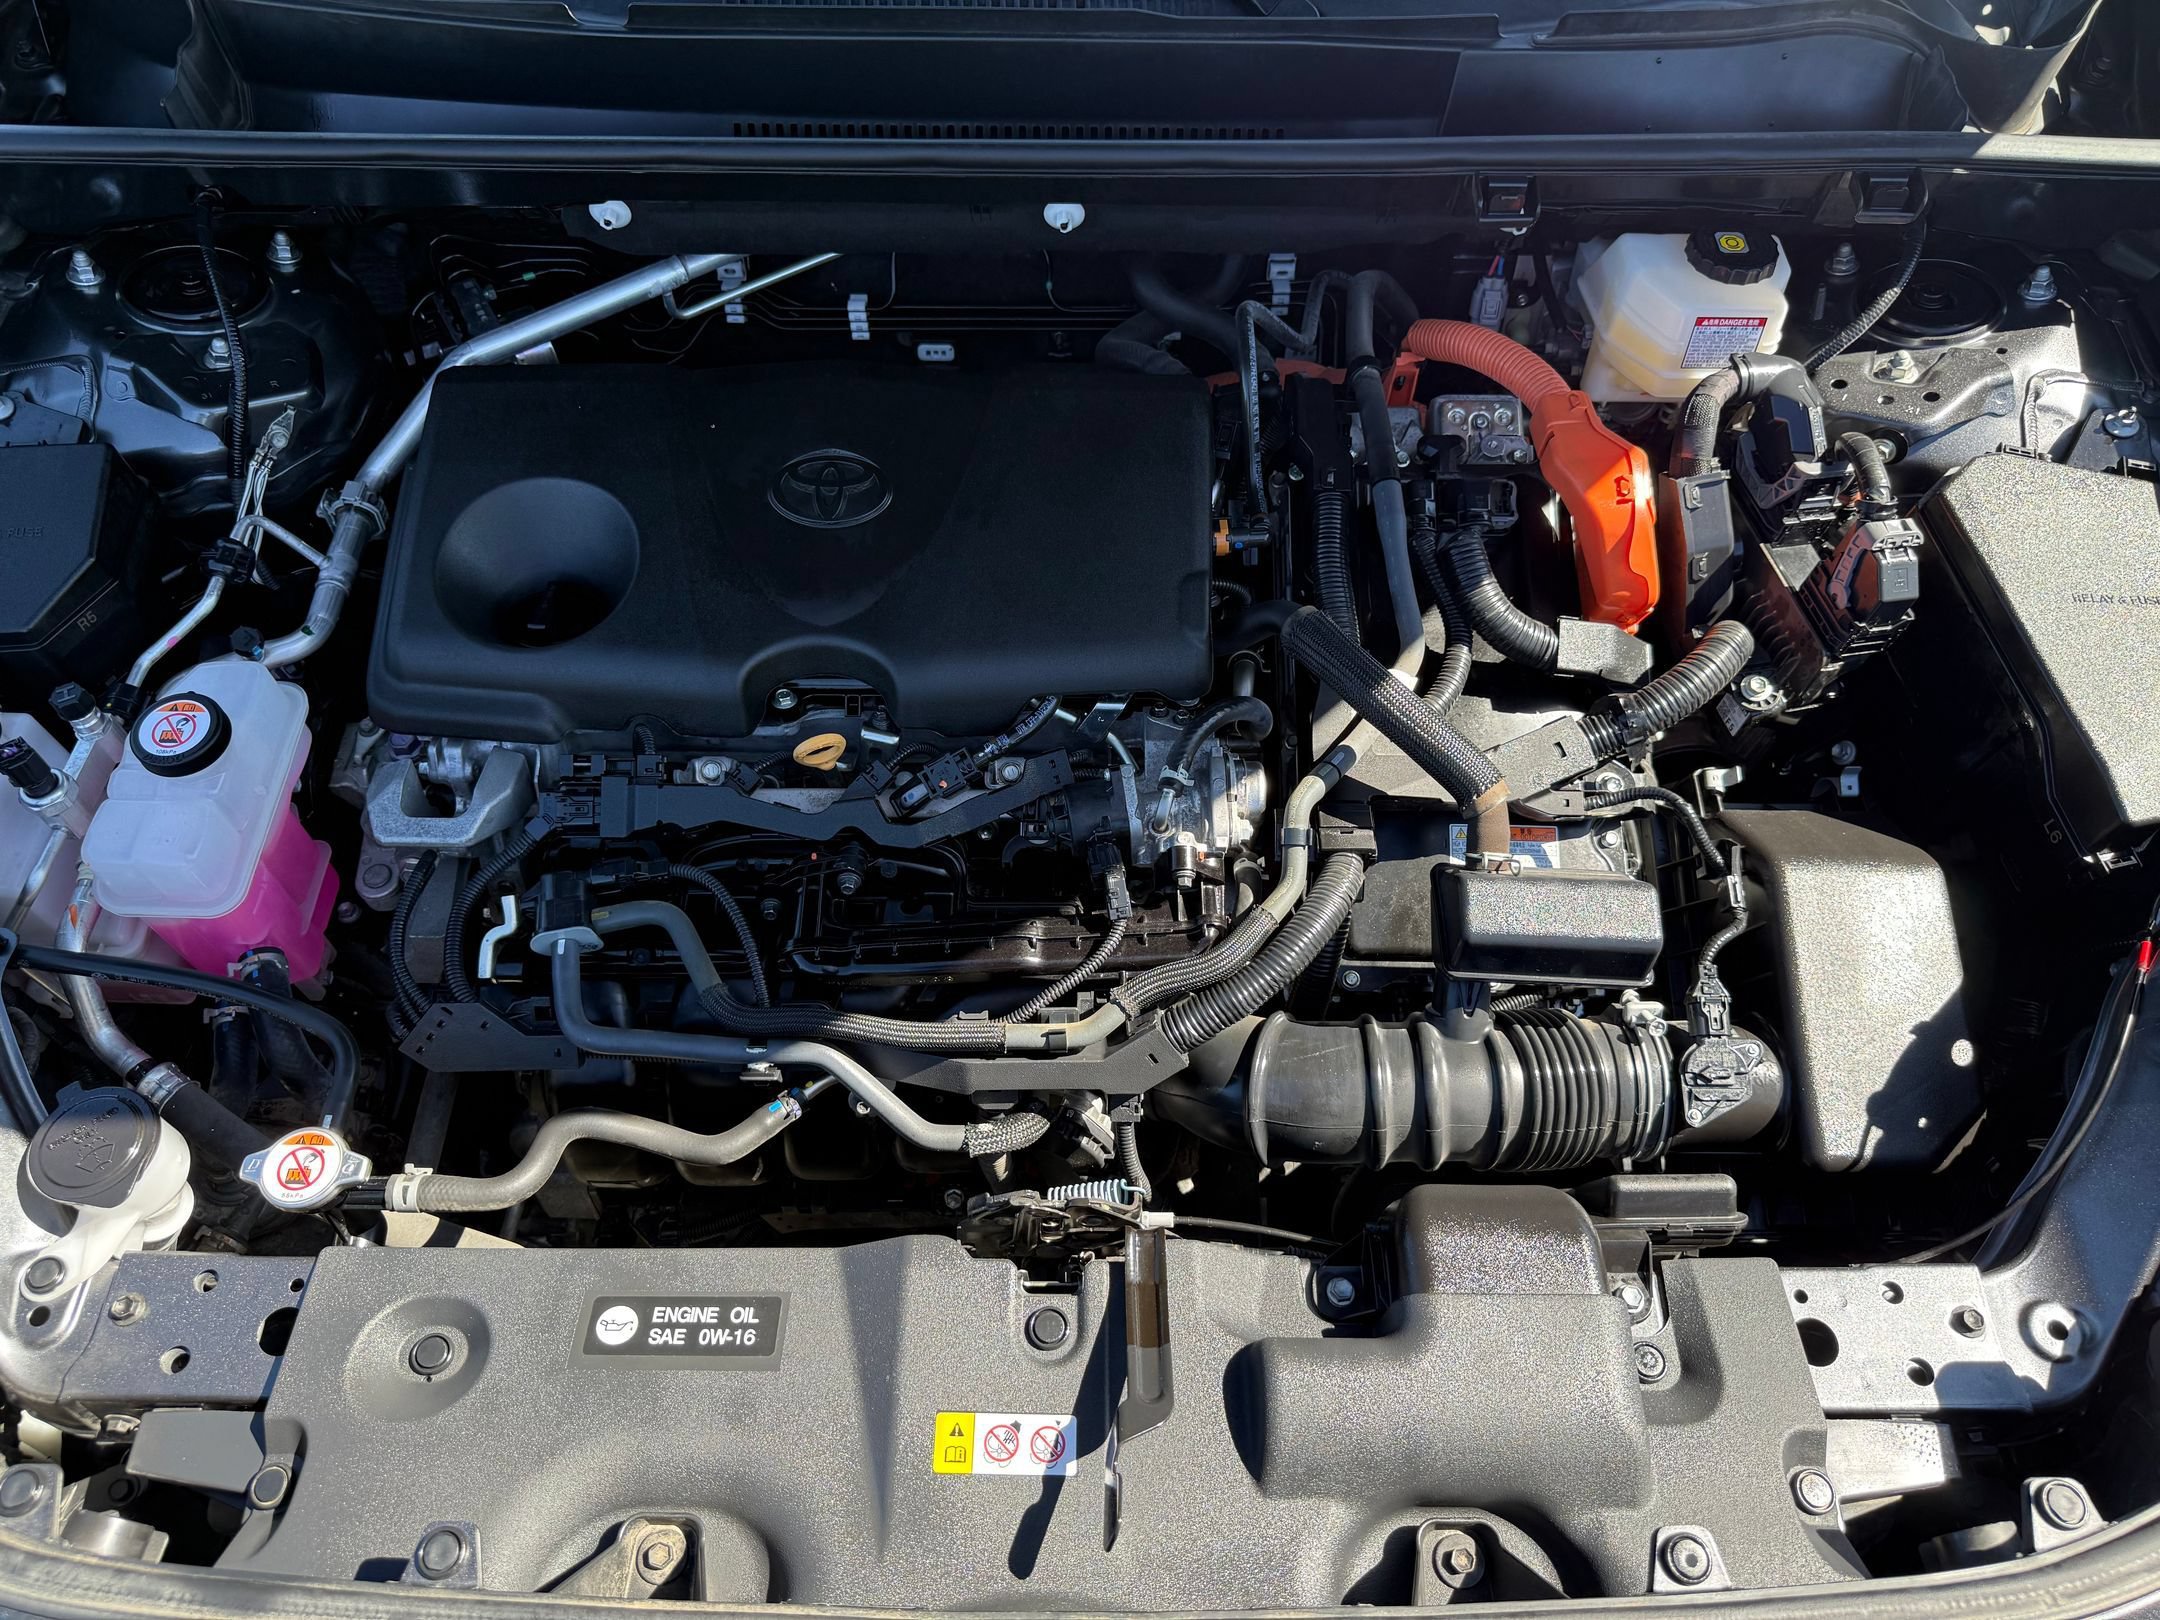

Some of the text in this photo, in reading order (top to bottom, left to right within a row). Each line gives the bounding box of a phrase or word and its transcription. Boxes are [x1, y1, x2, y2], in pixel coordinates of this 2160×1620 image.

[2071, 593, 2115, 604] RELAY
[77, 610, 97, 632] R5
[2043, 818, 2063, 844] L6
[651, 1306, 760, 1324] ENGINE OIL
[647, 1328, 757, 1346] SAE 0W-16
